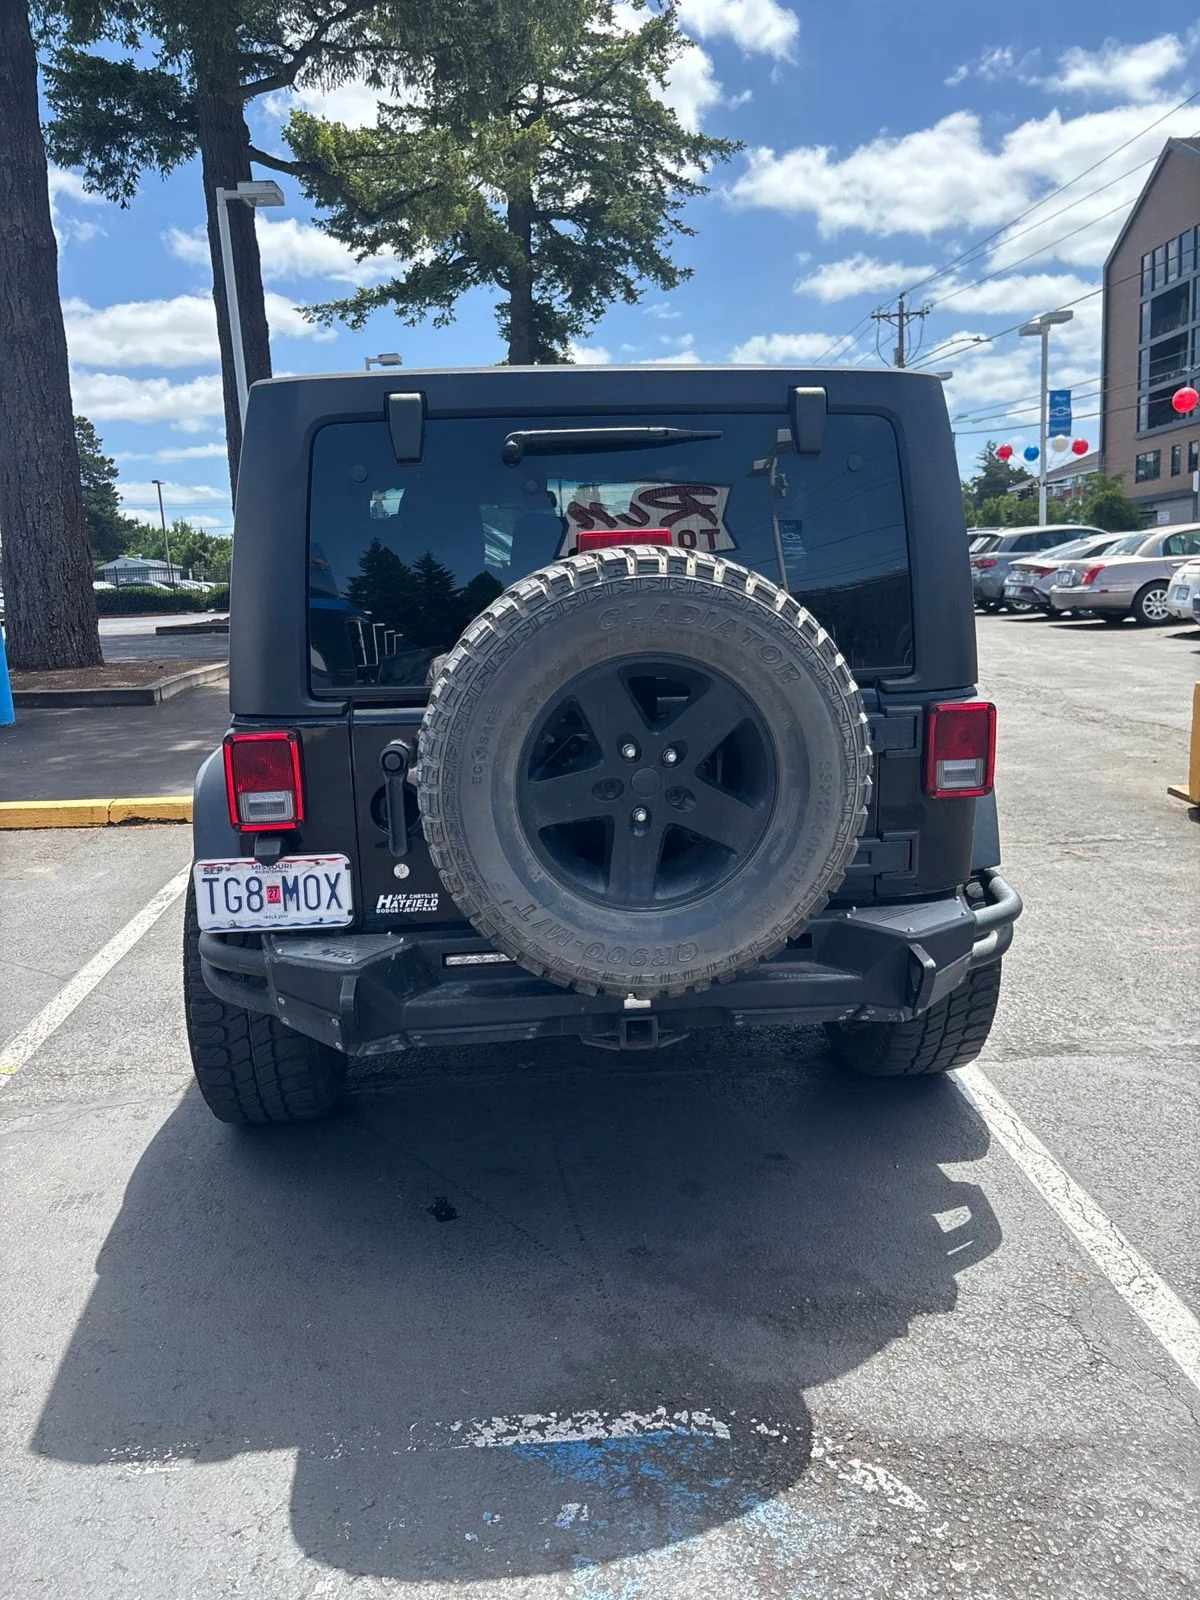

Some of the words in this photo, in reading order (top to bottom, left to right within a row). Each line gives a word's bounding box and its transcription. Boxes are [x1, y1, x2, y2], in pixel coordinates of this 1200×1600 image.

[598, 601, 802, 684] GLADIATOR
[203, 866, 224, 875] SEP
[202, 876, 264, 915] TG8
[281, 872, 343, 912] MOX
[268, 889, 278, 899] 27
[376, 894, 439, 908] HATFIELD
[511, 901, 699, 967] QR900-M/T
